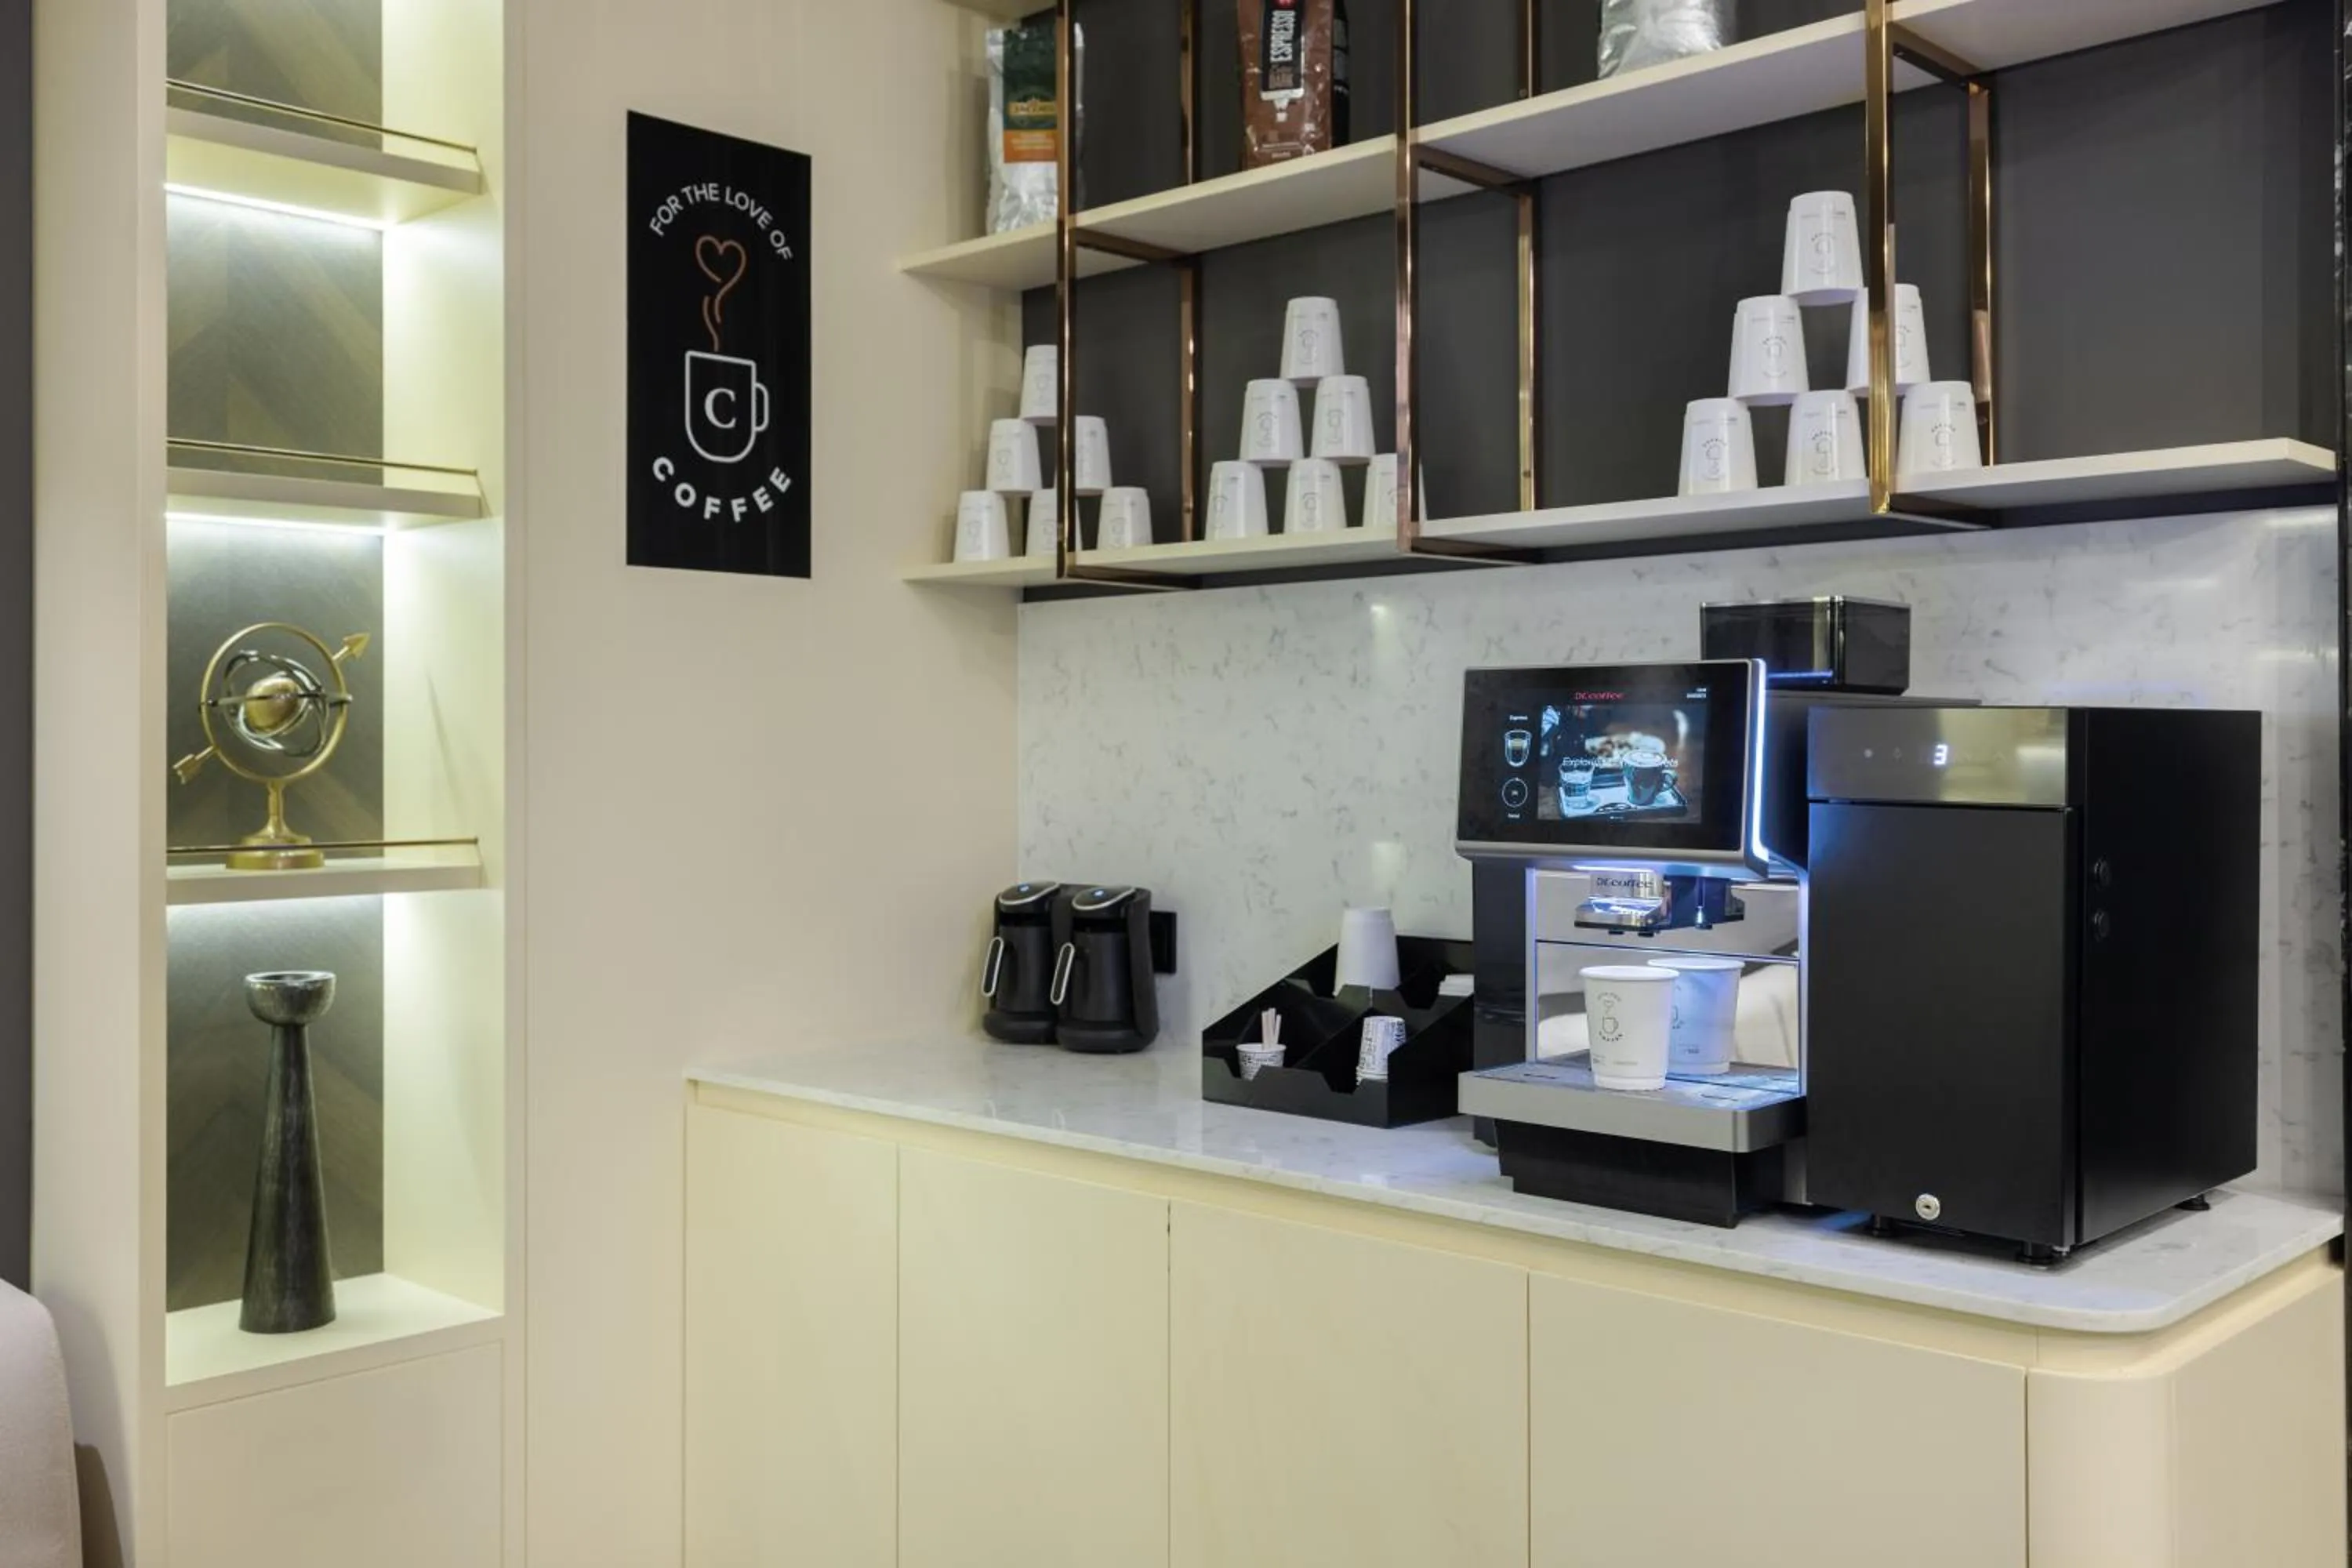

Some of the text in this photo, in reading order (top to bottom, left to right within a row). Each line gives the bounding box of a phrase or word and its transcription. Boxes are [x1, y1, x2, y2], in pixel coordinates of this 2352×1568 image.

[1270, 9, 1296, 63] ESPRESSO
[649, 183, 793, 260] FOR THE LOVE OF
[704, 387, 736, 429] C
[652, 456, 791, 523] COFFEE
[1933, 744, 1948, 765] 3
